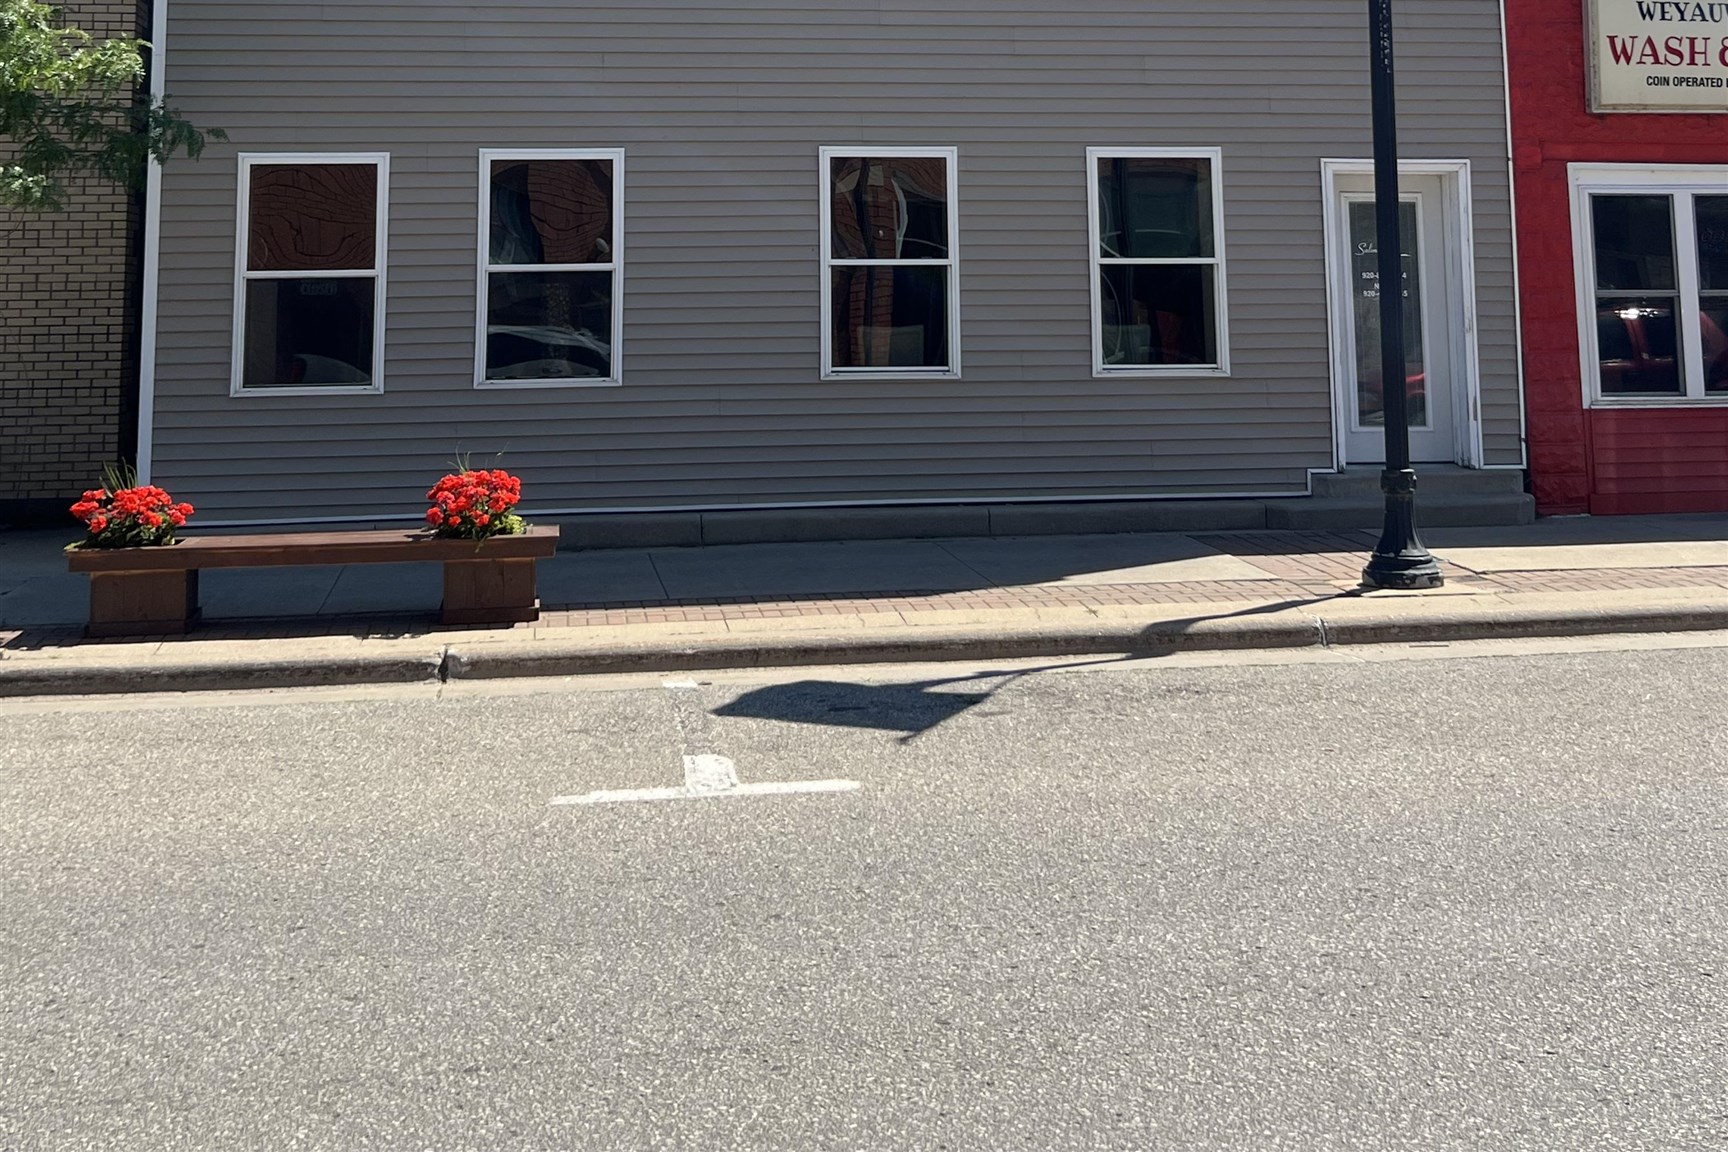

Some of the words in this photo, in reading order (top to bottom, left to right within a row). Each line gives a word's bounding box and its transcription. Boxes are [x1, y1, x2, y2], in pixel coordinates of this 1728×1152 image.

[1636, 1, 1728, 23] WEYAU
[1606, 35, 1711, 67] WASH
[1646, 76, 1670, 87] COIN
[1672, 76, 1723, 88] OPERATED
